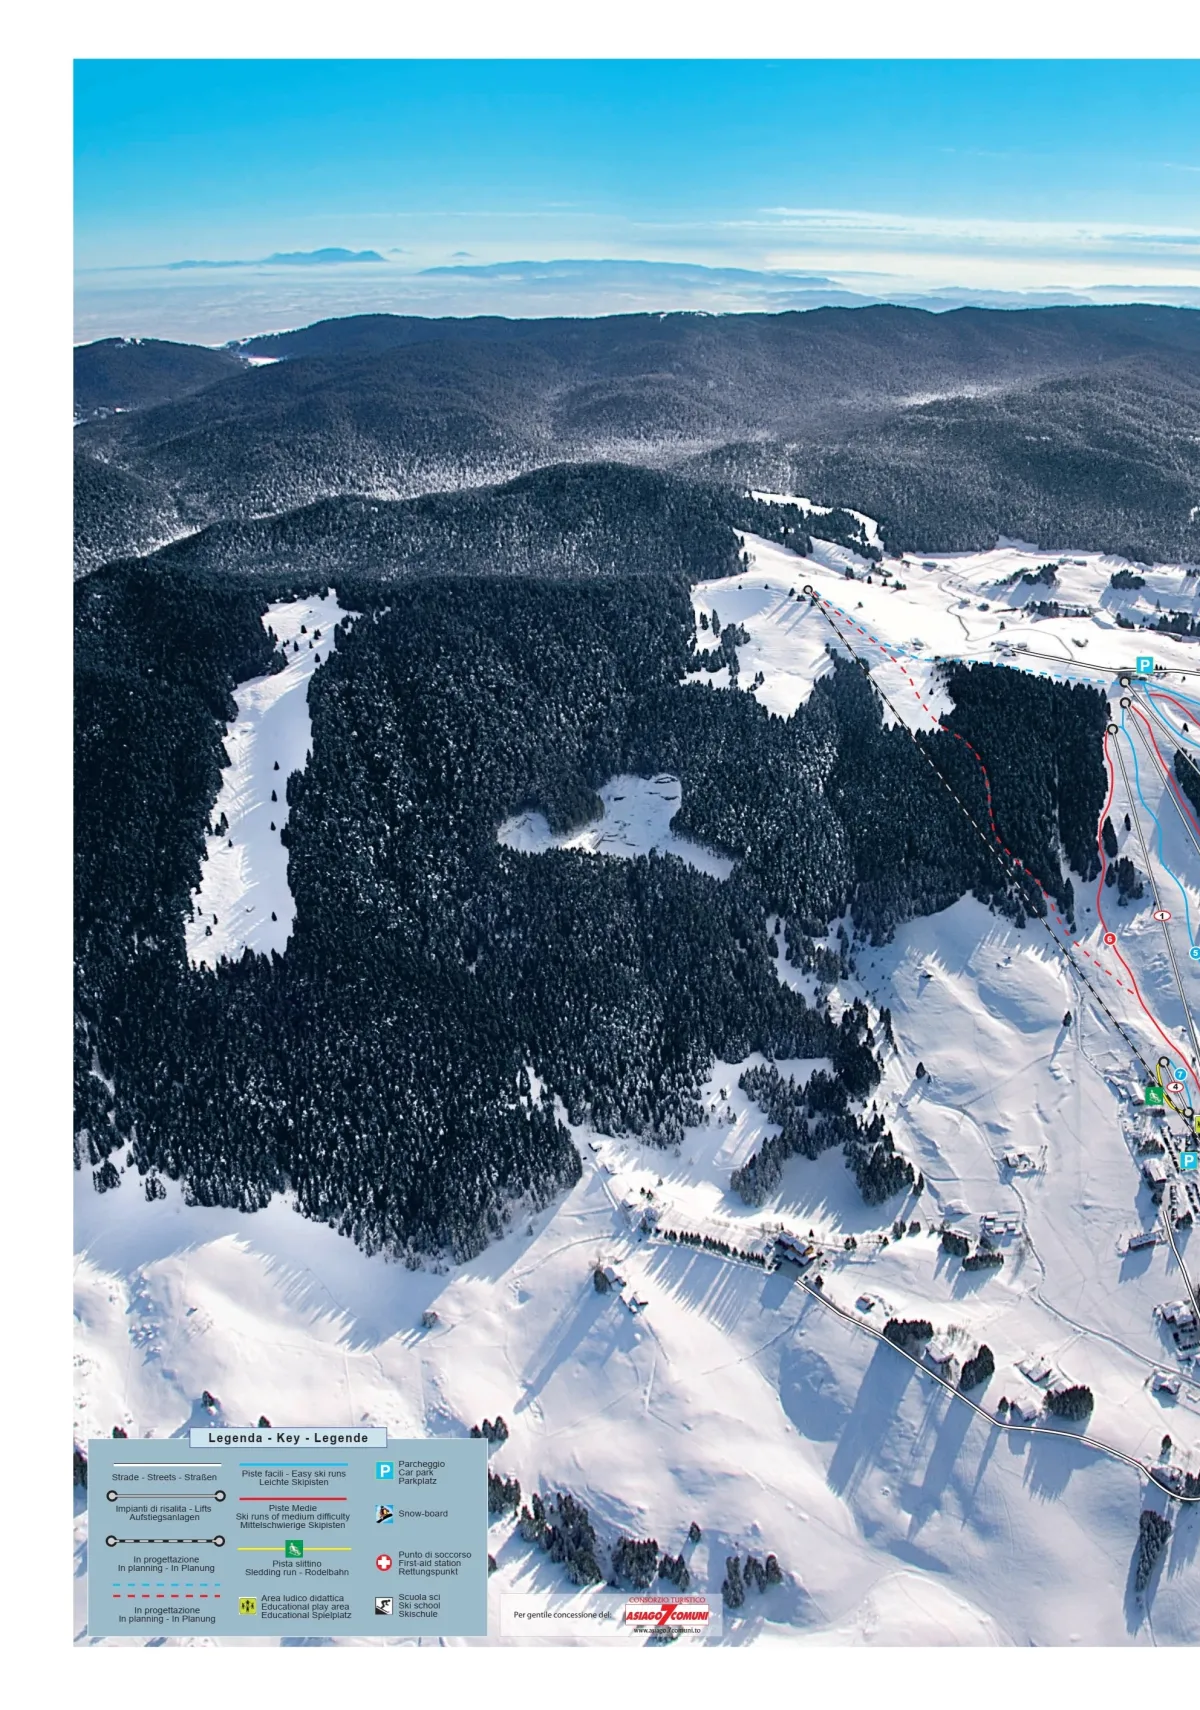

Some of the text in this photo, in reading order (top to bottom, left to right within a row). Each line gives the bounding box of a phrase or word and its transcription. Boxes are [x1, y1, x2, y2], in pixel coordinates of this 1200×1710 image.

[209, 1433, 368, 1445] Legenda Key Legende
[399, 1461, 445, 1469] Parcheggio
[292, 1470, 312, 1479] Easy
[416, 1469, 433, 1477] park
[292, 1478, 328, 1487] Skipisten
[399, 1478, 437, 1486] Parkplatz
[116, 1505, 148, 1514] Impianti
[129, 1513, 200, 1522] Aufstiegsanlagen
[271, 1512, 279, 1520] of
[317, 1513, 350, 1521] difficulty
[240, 1521, 346, 1530] Mittelschwierige Skipisten
[144, 1556, 199, 1565] progettazione
[273, 1560, 321, 1568] Pista slittino
[128, 1564, 163, 1573] planning
[181, 1565, 215, 1573] Planung
[246, 1569, 280, 1577] Sledding
[399, 1568, 458, 1577] Rettungspunkt
[312, 1604, 328, 1612] play
[312, 1611, 351, 1620] Spielplatz
